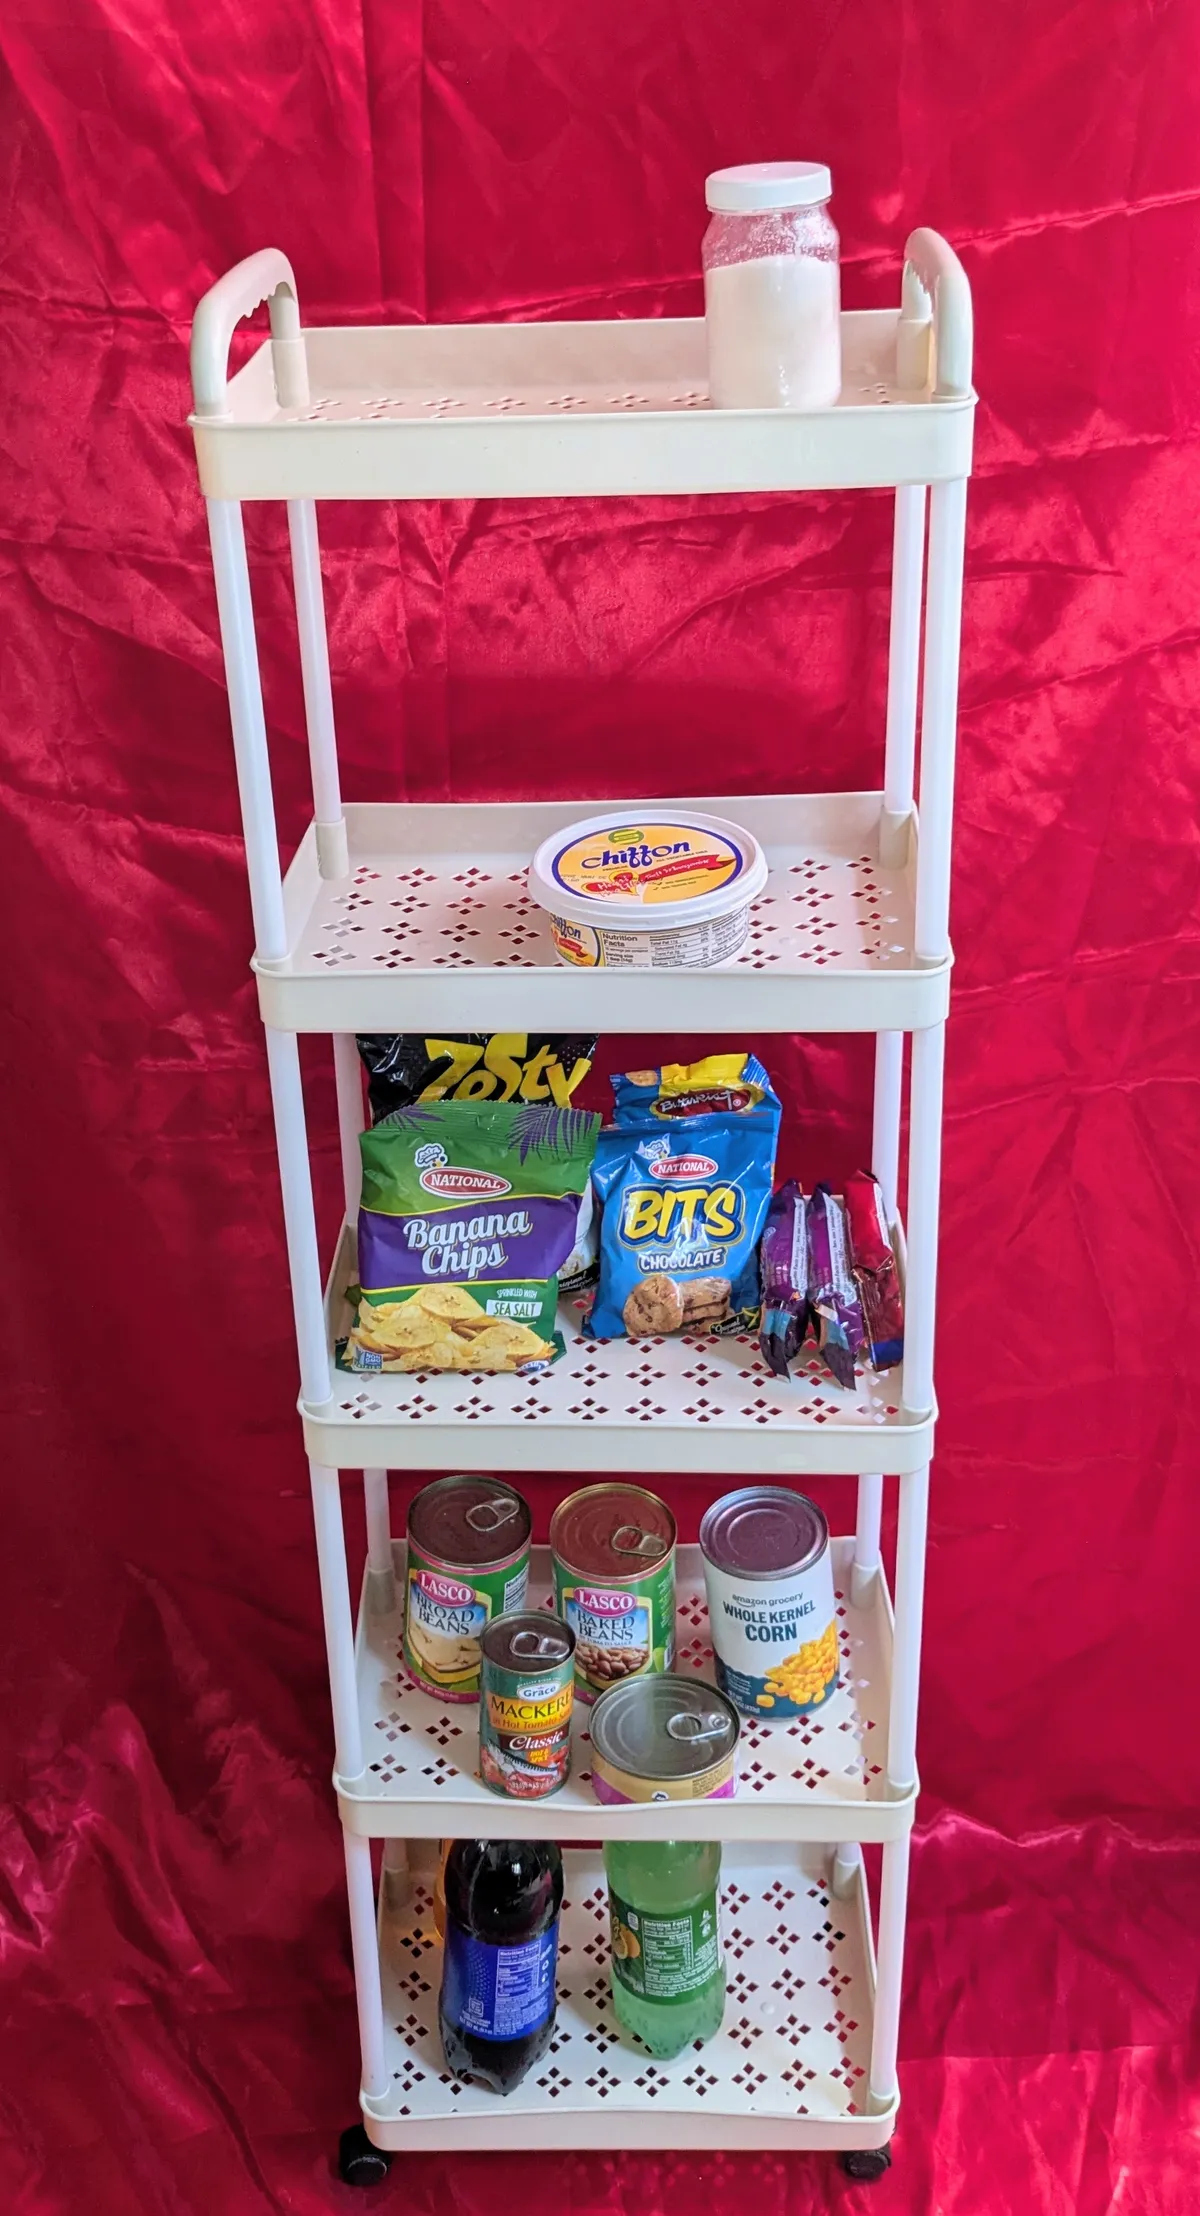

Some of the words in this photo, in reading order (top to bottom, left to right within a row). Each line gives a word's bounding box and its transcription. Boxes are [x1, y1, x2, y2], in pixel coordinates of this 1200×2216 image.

[582, 842, 690, 869] chiffon
[603, 932, 638, 942] Nutrition
[604, 939, 625, 947] Facts
[657, 1161, 710, 1174] NATIONAL
[430, 1173, 501, 1189] NATIONAL
[623, 1186, 737, 1239] BITS
[403, 1210, 533, 1250] Banana
[422, 1242, 508, 1279] Chips
[639, 1247, 724, 1271] CHOCOLATE
[496, 1288, 523, 1298] SPRINKLED
[494, 1302, 511, 1316] SEA
[513, 1302, 536, 1317] SALT
[421, 1573, 471, 1601] LASCO
[416, 1592, 475, 1623] BROAD
[579, 1589, 633, 1610] LASCO
[732, 1593, 767, 1607] amazon
[768, 1592, 803, 1607] grocery
[418, 1607, 470, 1635] BEANS
[577, 1609, 635, 1630] BAKED
[722, 1600, 767, 1624] WHOLE
[769, 1599, 816, 1624] KERNEL
[579, 1621, 634, 1641] BEANS
[745, 1621, 797, 1643] CORN
[523, 1685, 556, 1698] Grace
[502, 1719, 520, 1729] Hot
[523, 1715, 559, 1730] Tomato
[509, 1731, 563, 1750] Classic
